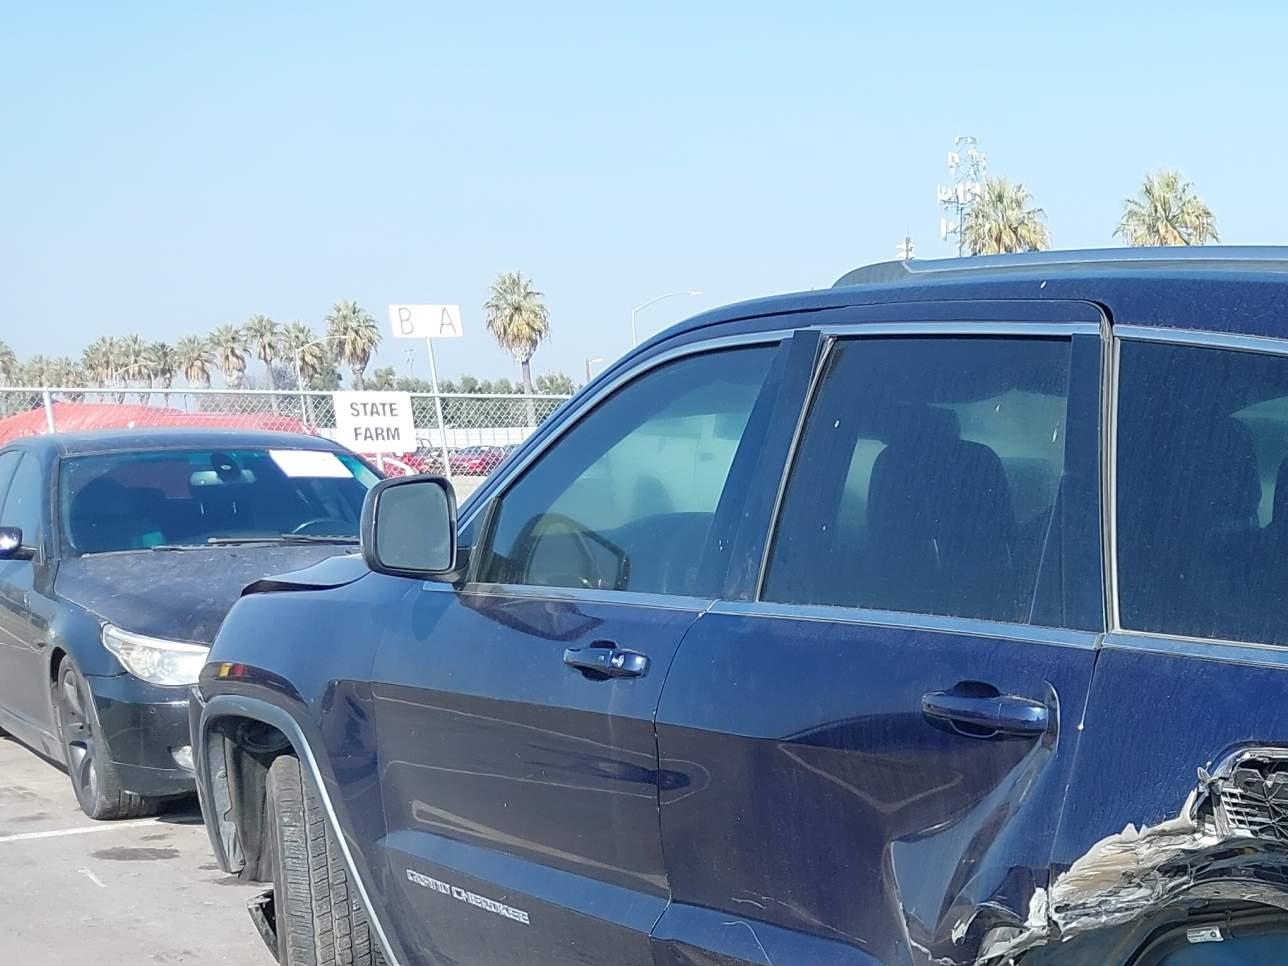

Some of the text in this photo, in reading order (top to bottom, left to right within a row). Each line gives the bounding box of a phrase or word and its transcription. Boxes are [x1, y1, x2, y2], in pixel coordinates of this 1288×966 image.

[398, 306, 457, 335] B A
[350, 402, 398, 417] STATE
[354, 427, 400, 441] FARM
[451, 886, 530, 925] CHEROKEE
